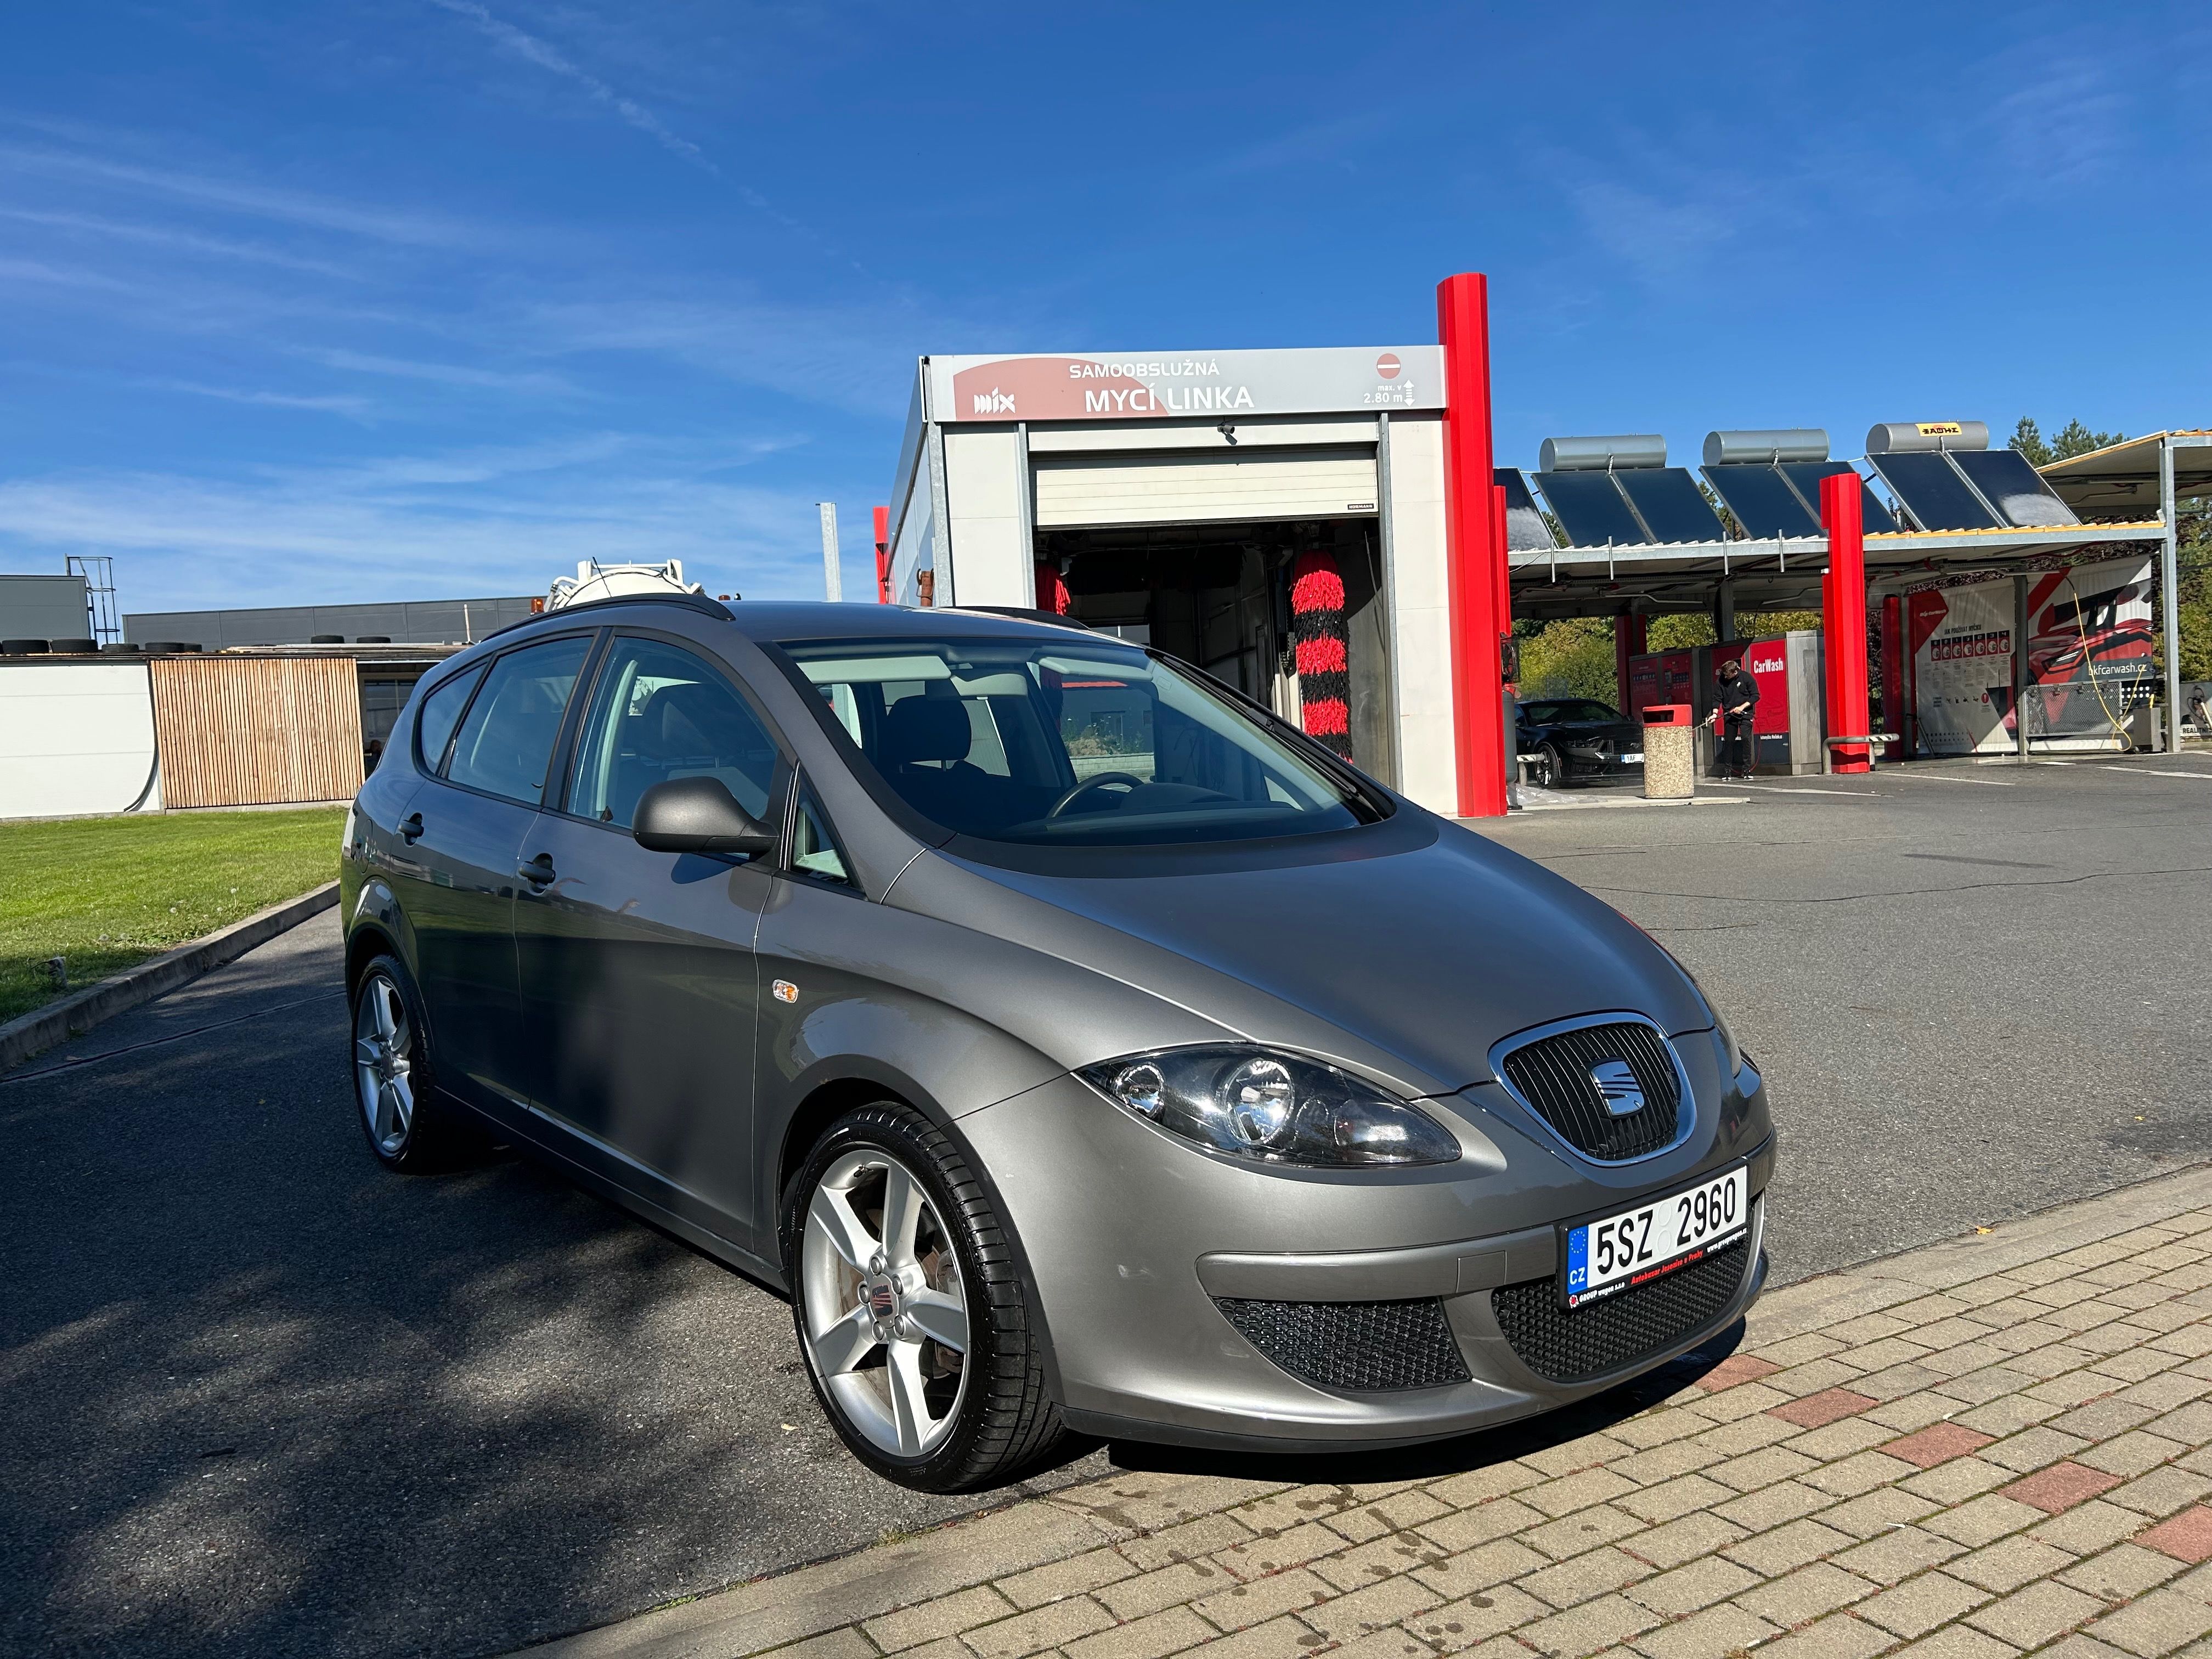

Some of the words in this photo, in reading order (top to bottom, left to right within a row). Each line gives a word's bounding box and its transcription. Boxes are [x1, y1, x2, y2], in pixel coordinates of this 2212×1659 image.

[1070, 358, 1220, 379] SAMOOBSLUŽNÁ
[1085, 382, 1155, 413] MYCÍ
[1167, 386, 1255, 410] LINKA
[1363, 392, 1390, 404] 2.80
[1393, 394, 1403, 403] m
[1754, 657, 1784, 674] CarWash
[1597, 1209, 1654, 1274] 5SZ
[1677, 1177, 1736, 1246] 2960
[1570, 1267, 1585, 1285] CZ
[1630, 1268, 1661, 1285] Autobazar
[1579, 1290, 1598, 1302] GROUP
